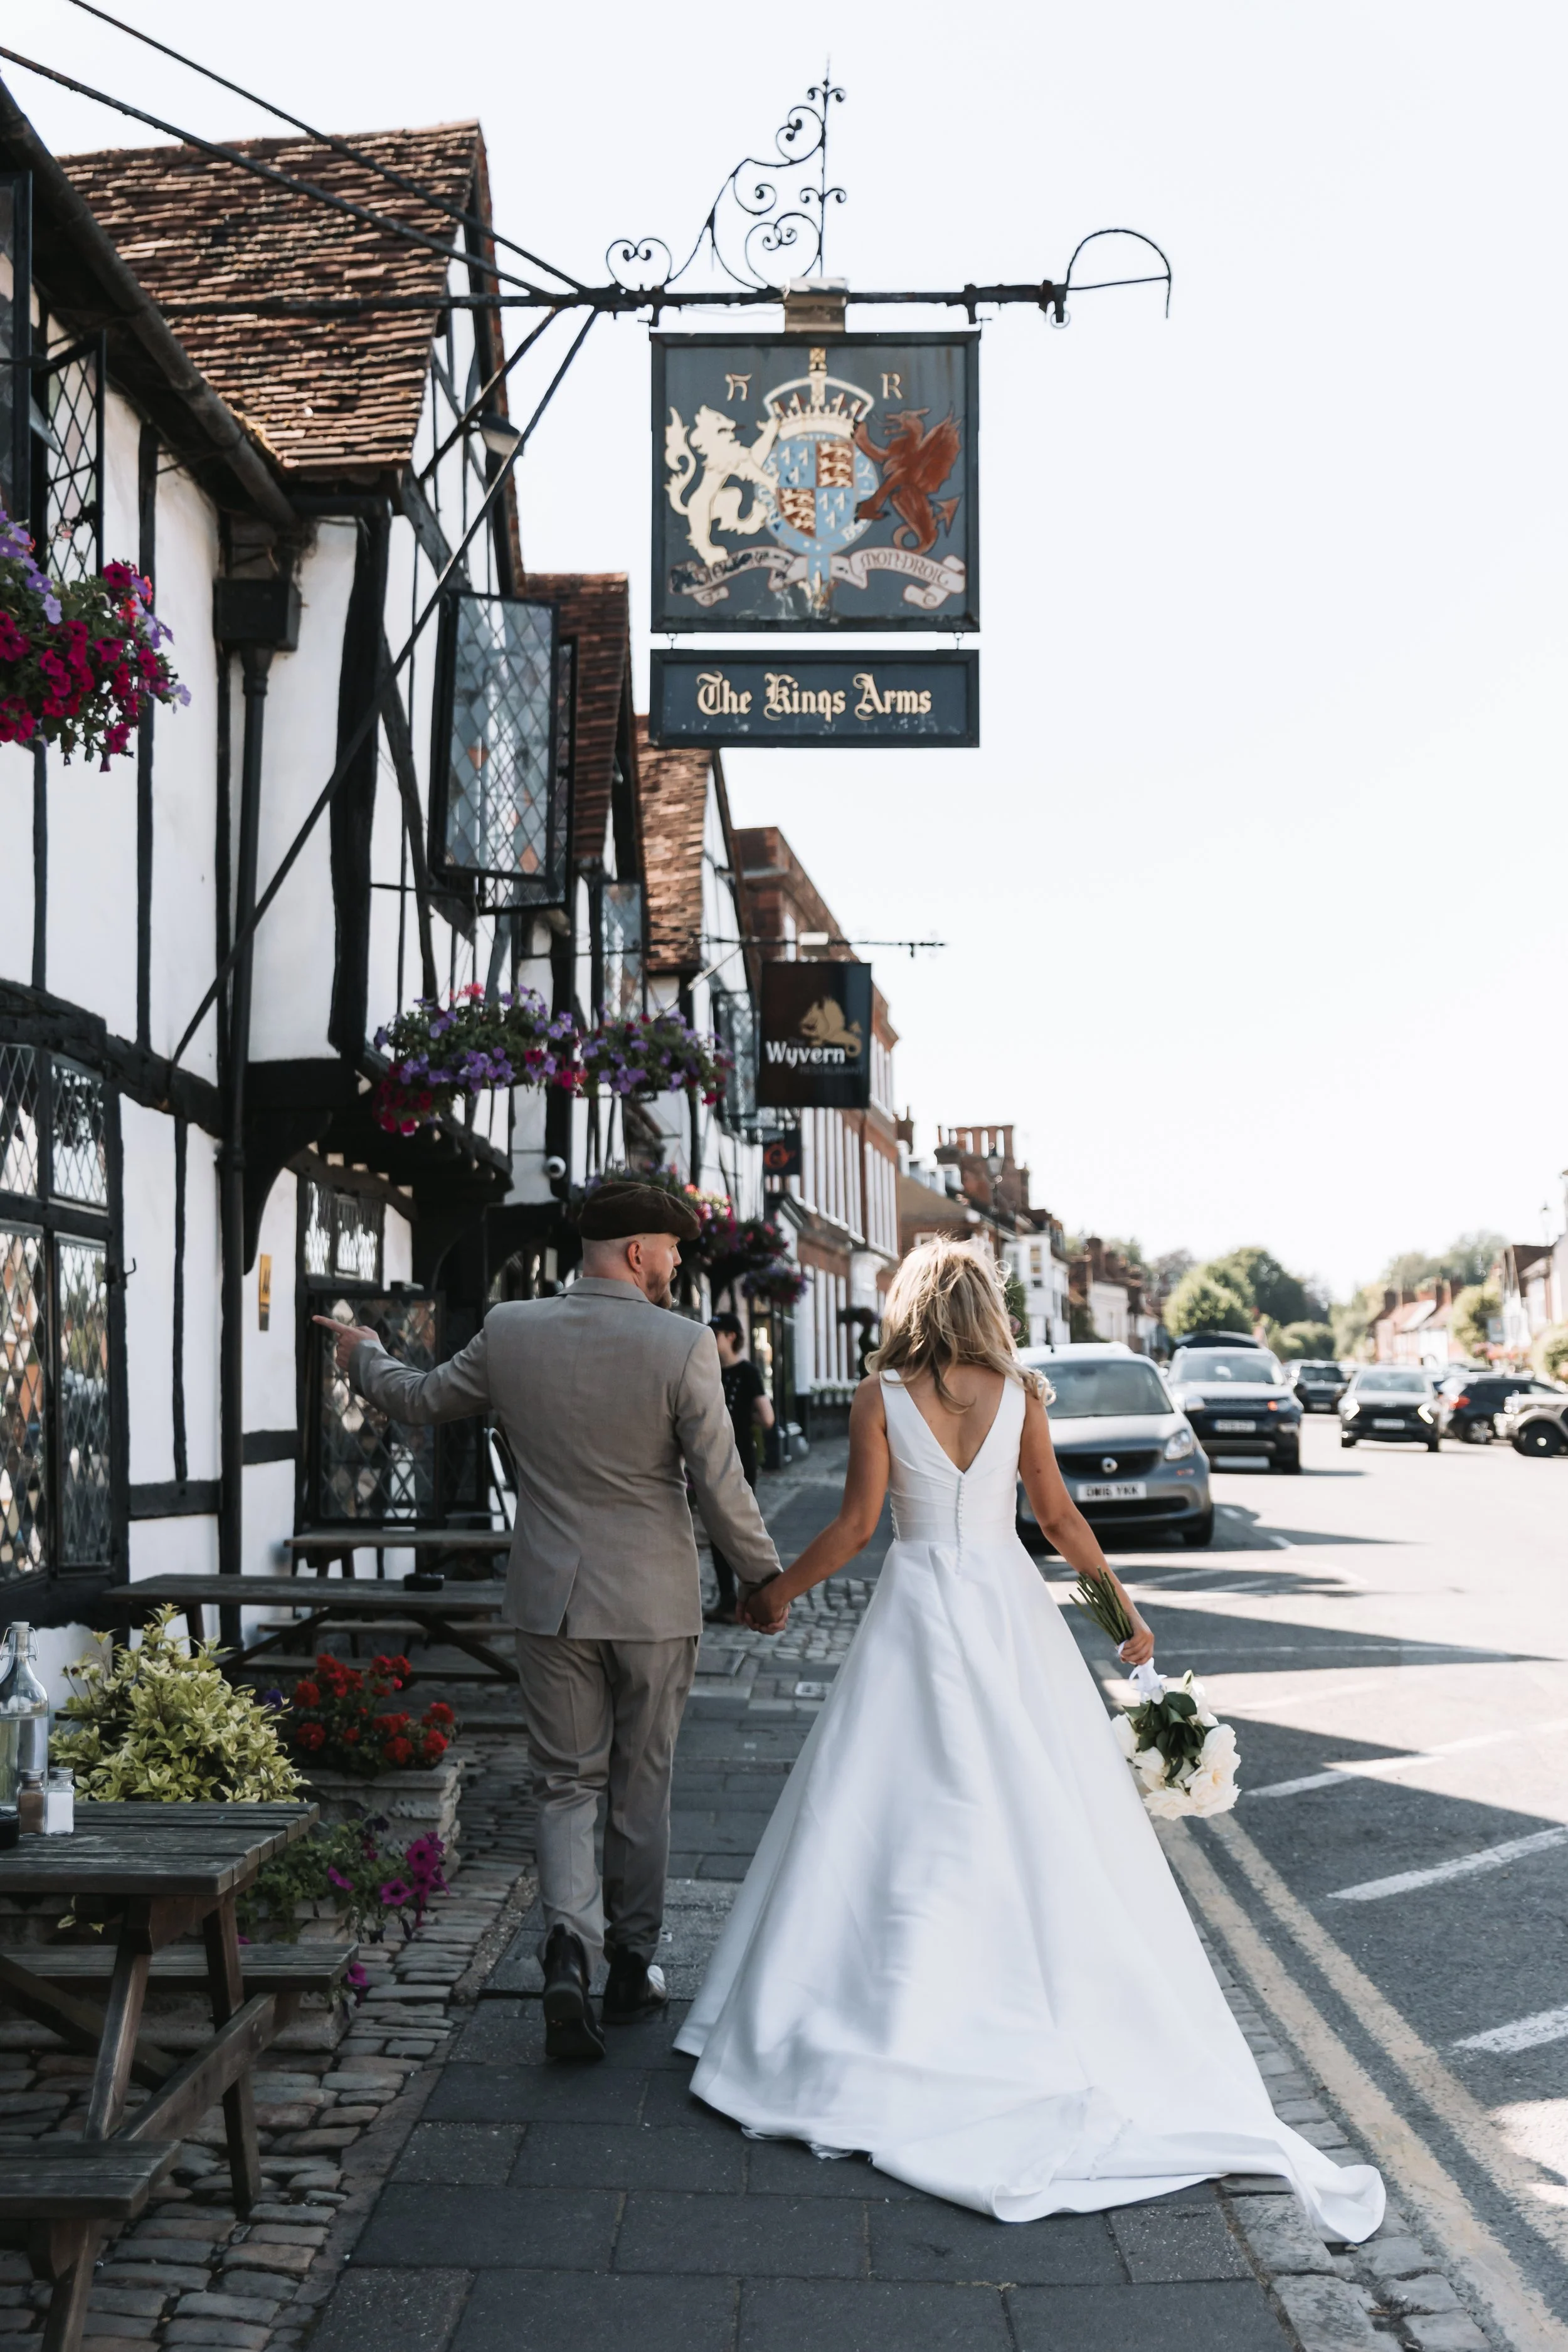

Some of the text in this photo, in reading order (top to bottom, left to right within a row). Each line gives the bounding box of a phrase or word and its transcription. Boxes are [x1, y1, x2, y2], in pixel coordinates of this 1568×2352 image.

[880, 373, 903, 400] R
[696, 670, 932, 723] The Kings Arms
[765, 1040, 846, 1069] Wyvern
